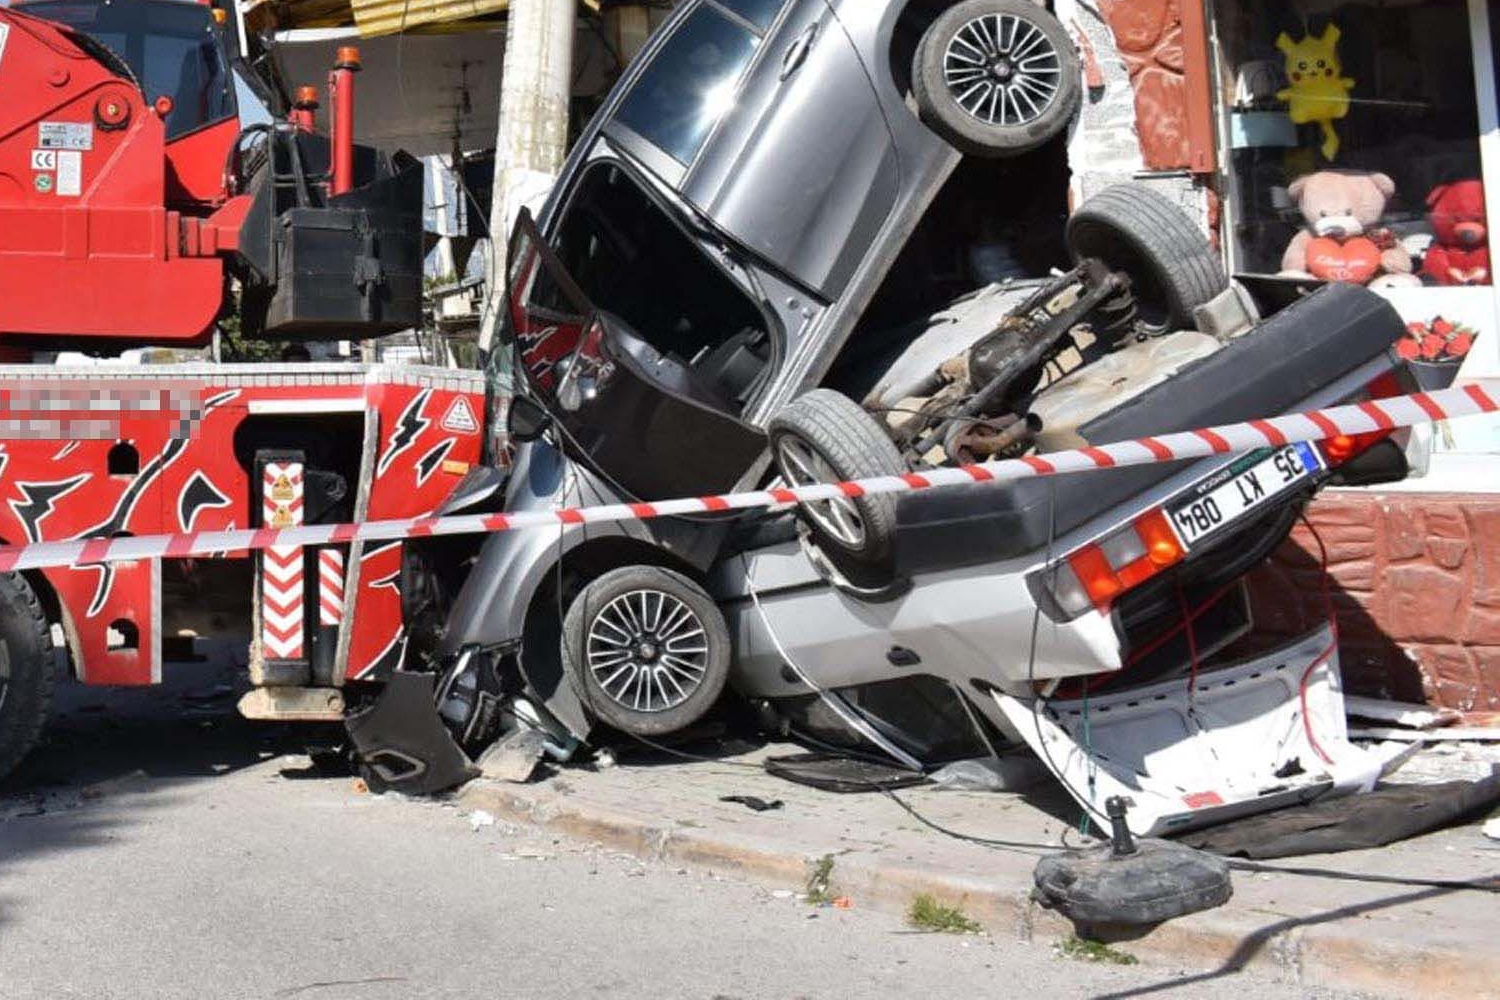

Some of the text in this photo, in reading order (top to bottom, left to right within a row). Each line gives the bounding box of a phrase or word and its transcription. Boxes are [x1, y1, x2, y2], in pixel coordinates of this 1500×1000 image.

[1274, 448, 1304, 482] 35
[1235, 471, 1266, 507] KT
[1178, 496, 1223, 537] 084
